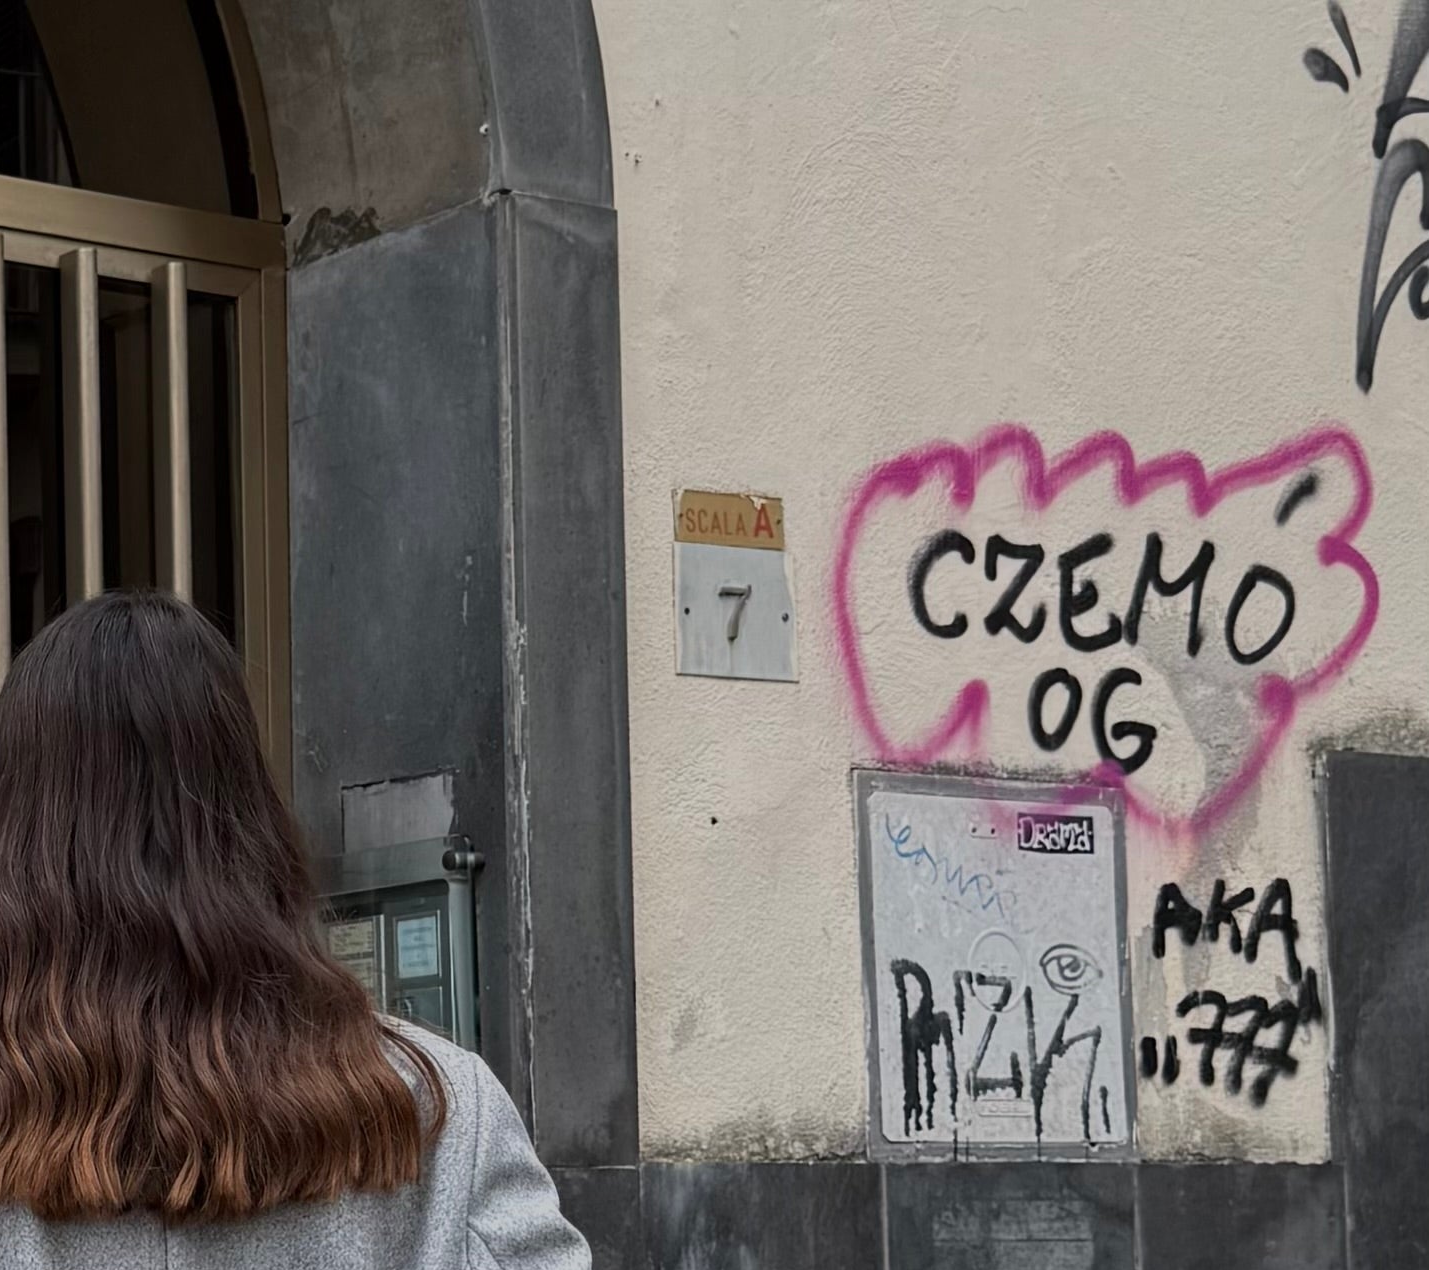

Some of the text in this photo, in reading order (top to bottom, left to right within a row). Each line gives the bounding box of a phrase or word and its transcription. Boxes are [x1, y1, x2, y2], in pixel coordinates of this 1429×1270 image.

[685, 502, 775, 539] SCALA A
[718, 583, 753, 642] 7
[1027, 667, 1157, 775] OG
[1152, 877, 1303, 986] AKA
